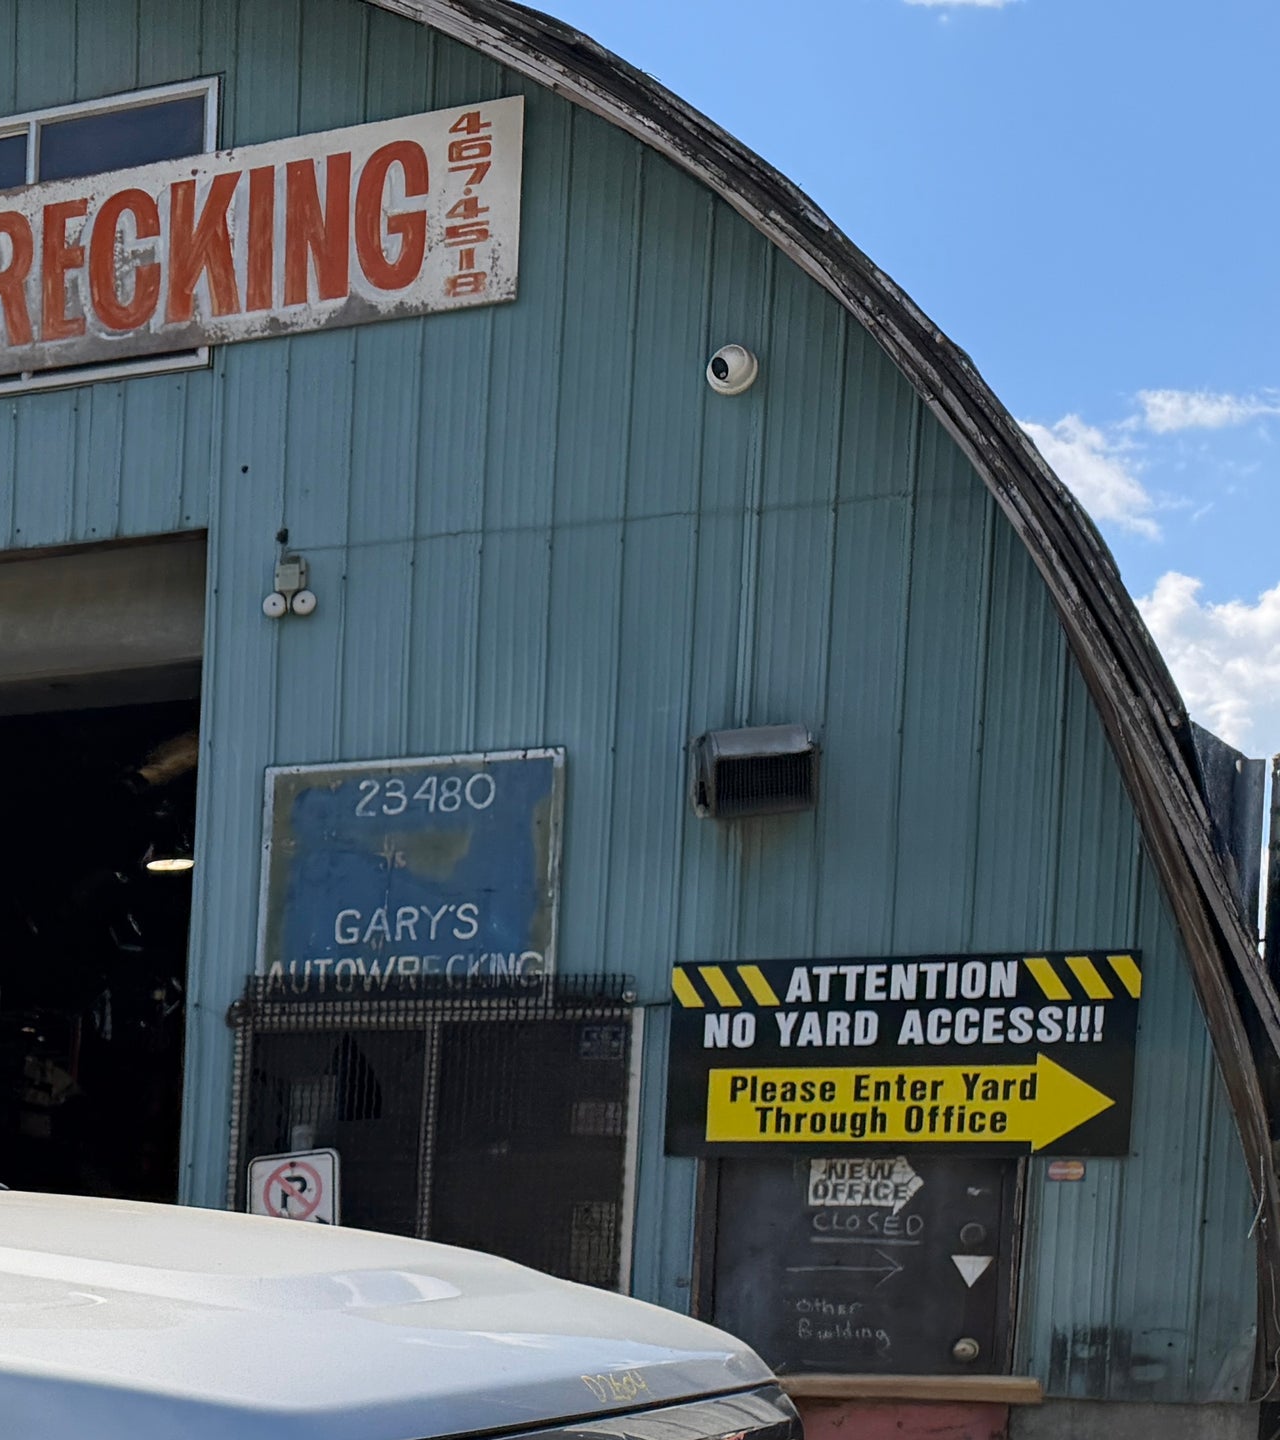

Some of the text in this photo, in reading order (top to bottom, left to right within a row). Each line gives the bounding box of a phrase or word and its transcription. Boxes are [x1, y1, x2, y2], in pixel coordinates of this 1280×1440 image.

[355, 772, 498, 819] 23480
[334, 902, 480, 946] GARY'S
[785, 960, 1019, 1004] ATTENTION
[702, 1005, 1106, 1049] NO YARD ACCESS!!!
[729, 1072, 1038, 1103] Please Enter Yard
[755, 1104, 1008, 1138] Through Office
[827, 1160, 895, 1181] NEW
[812, 1180, 908, 1201] OFFICE
[812, 1211, 924, 1236] CLOSED
